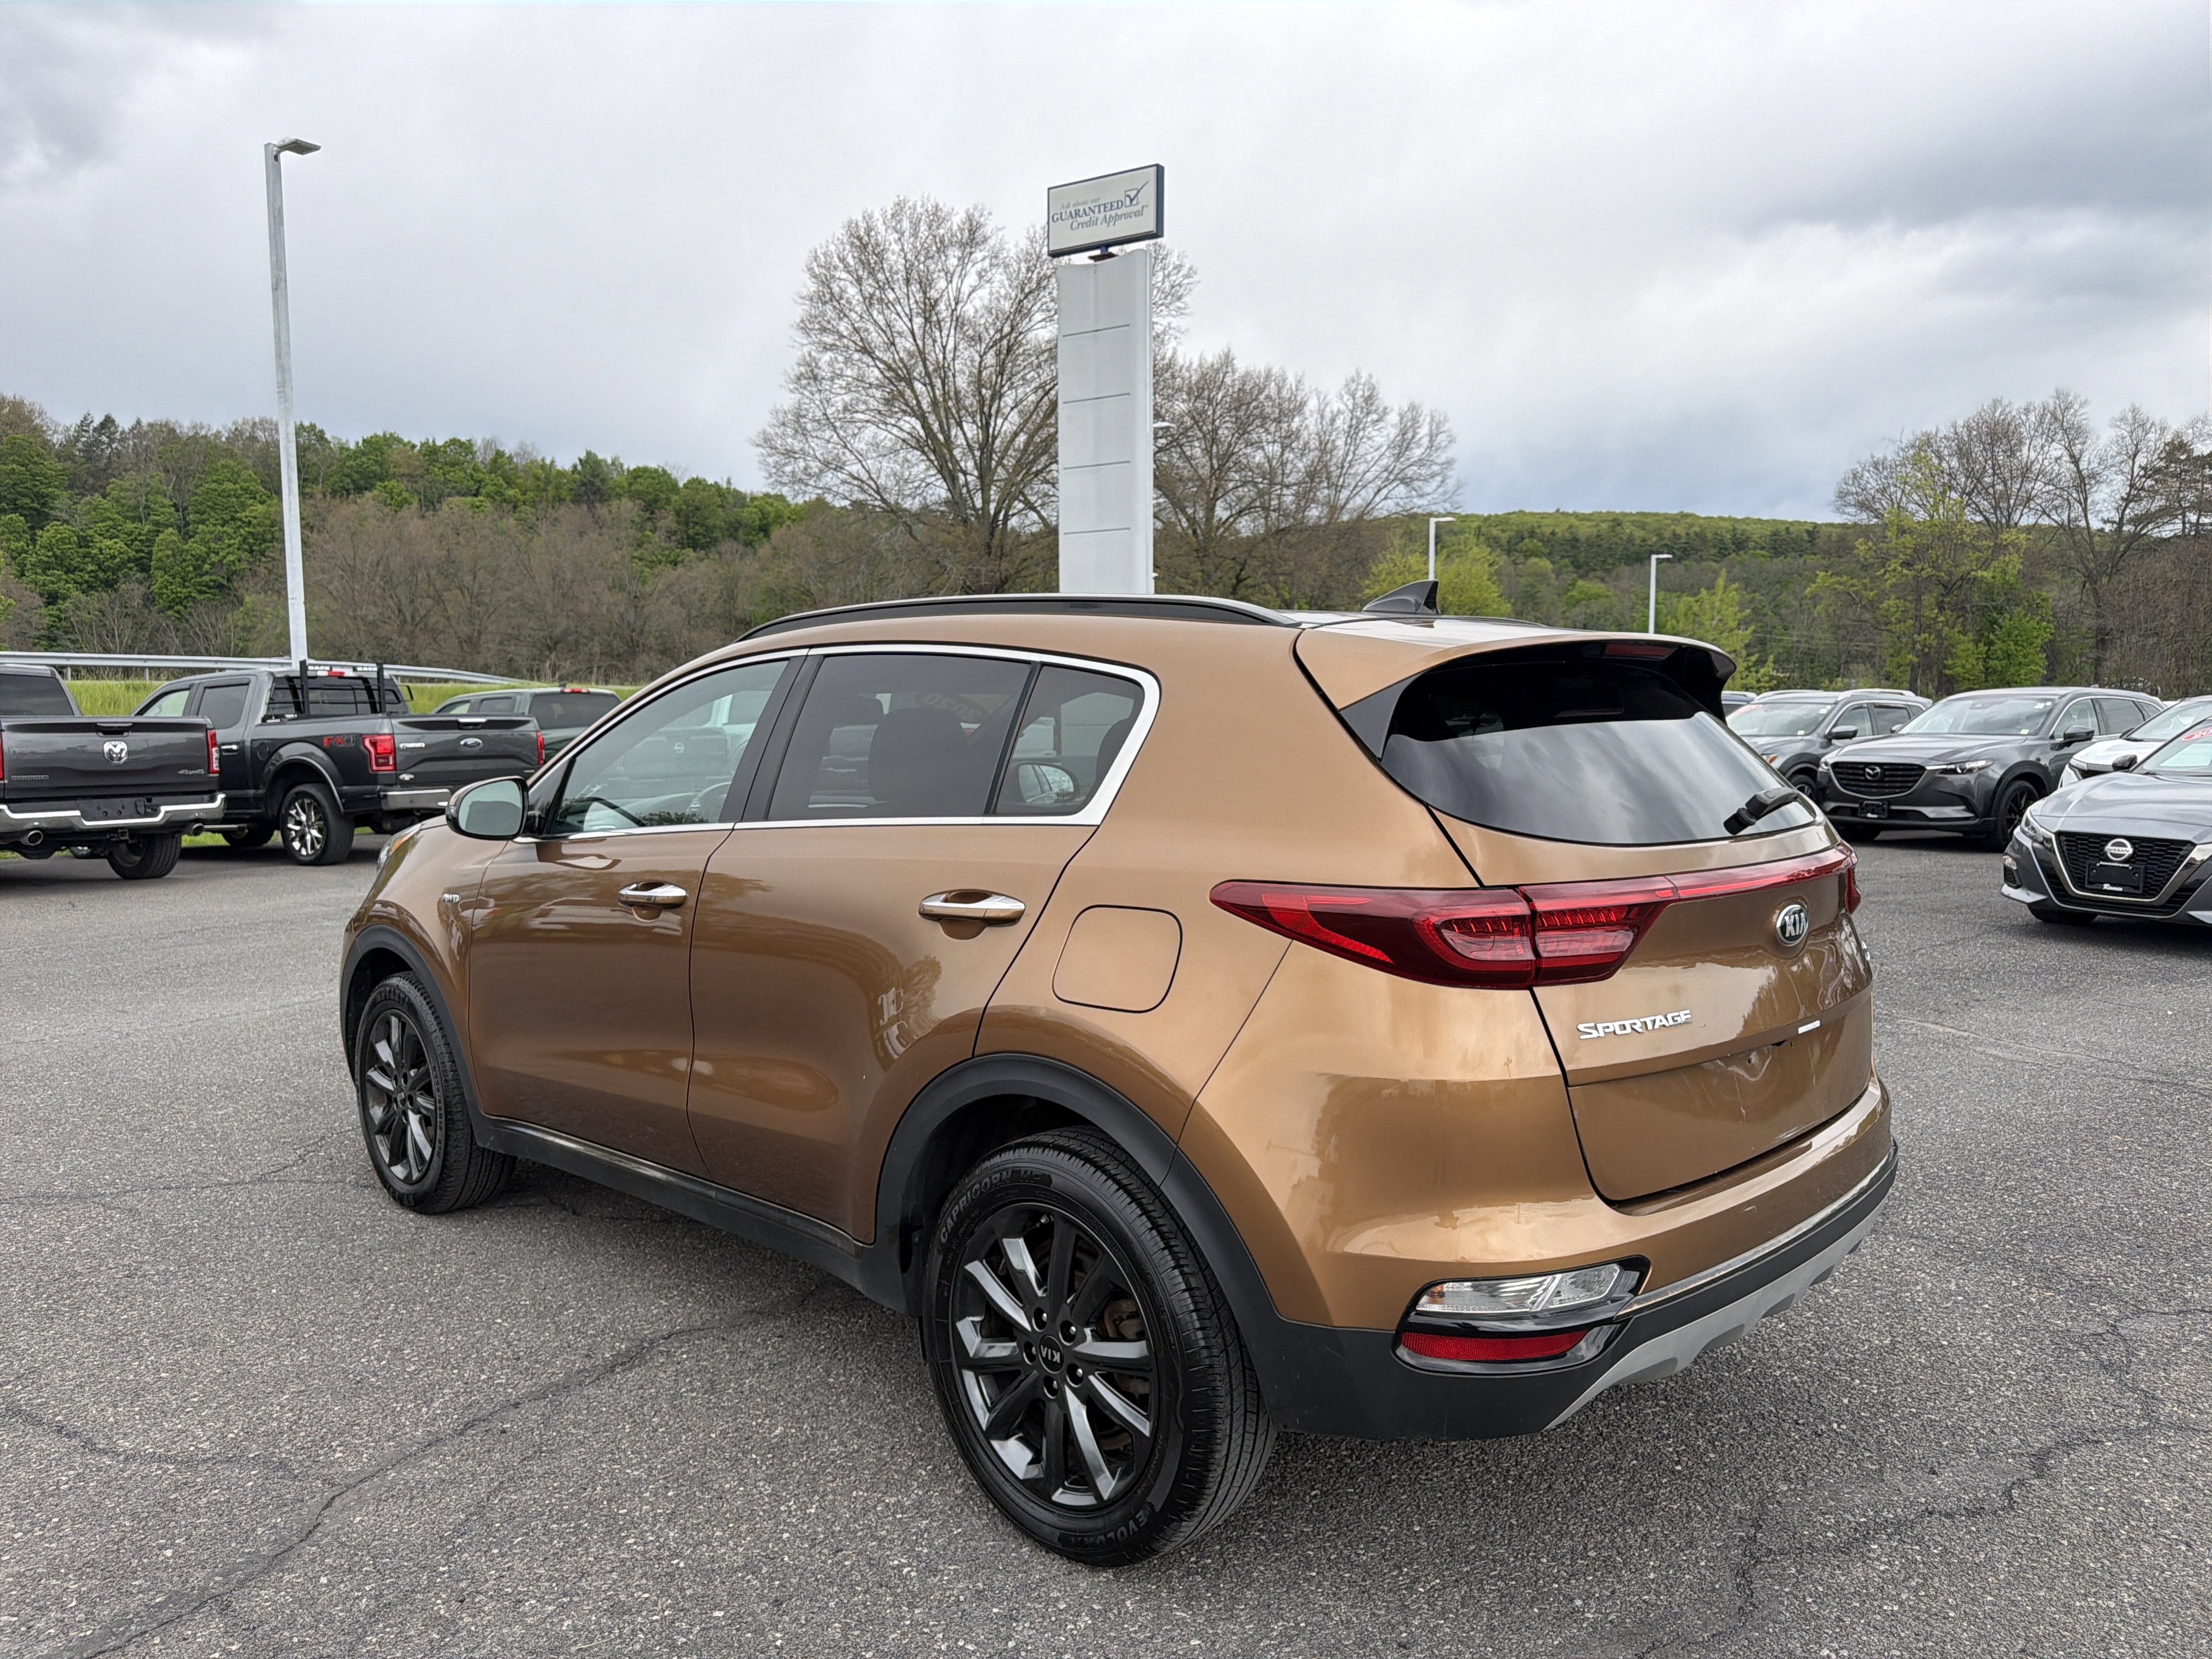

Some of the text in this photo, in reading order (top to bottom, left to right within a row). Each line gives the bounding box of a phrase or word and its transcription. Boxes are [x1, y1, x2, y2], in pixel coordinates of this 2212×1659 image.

[1052, 199, 1124, 223] GUARANTEED
[1070, 205, 1145, 231] Credit Approval
[1785, 912, 1807, 937] KIA
[1577, 1009, 1692, 1040] SPORTAGE
[940, 1170, 1013, 1245] CAPRICORN
[1040, 1345, 1061, 1364] KIA
